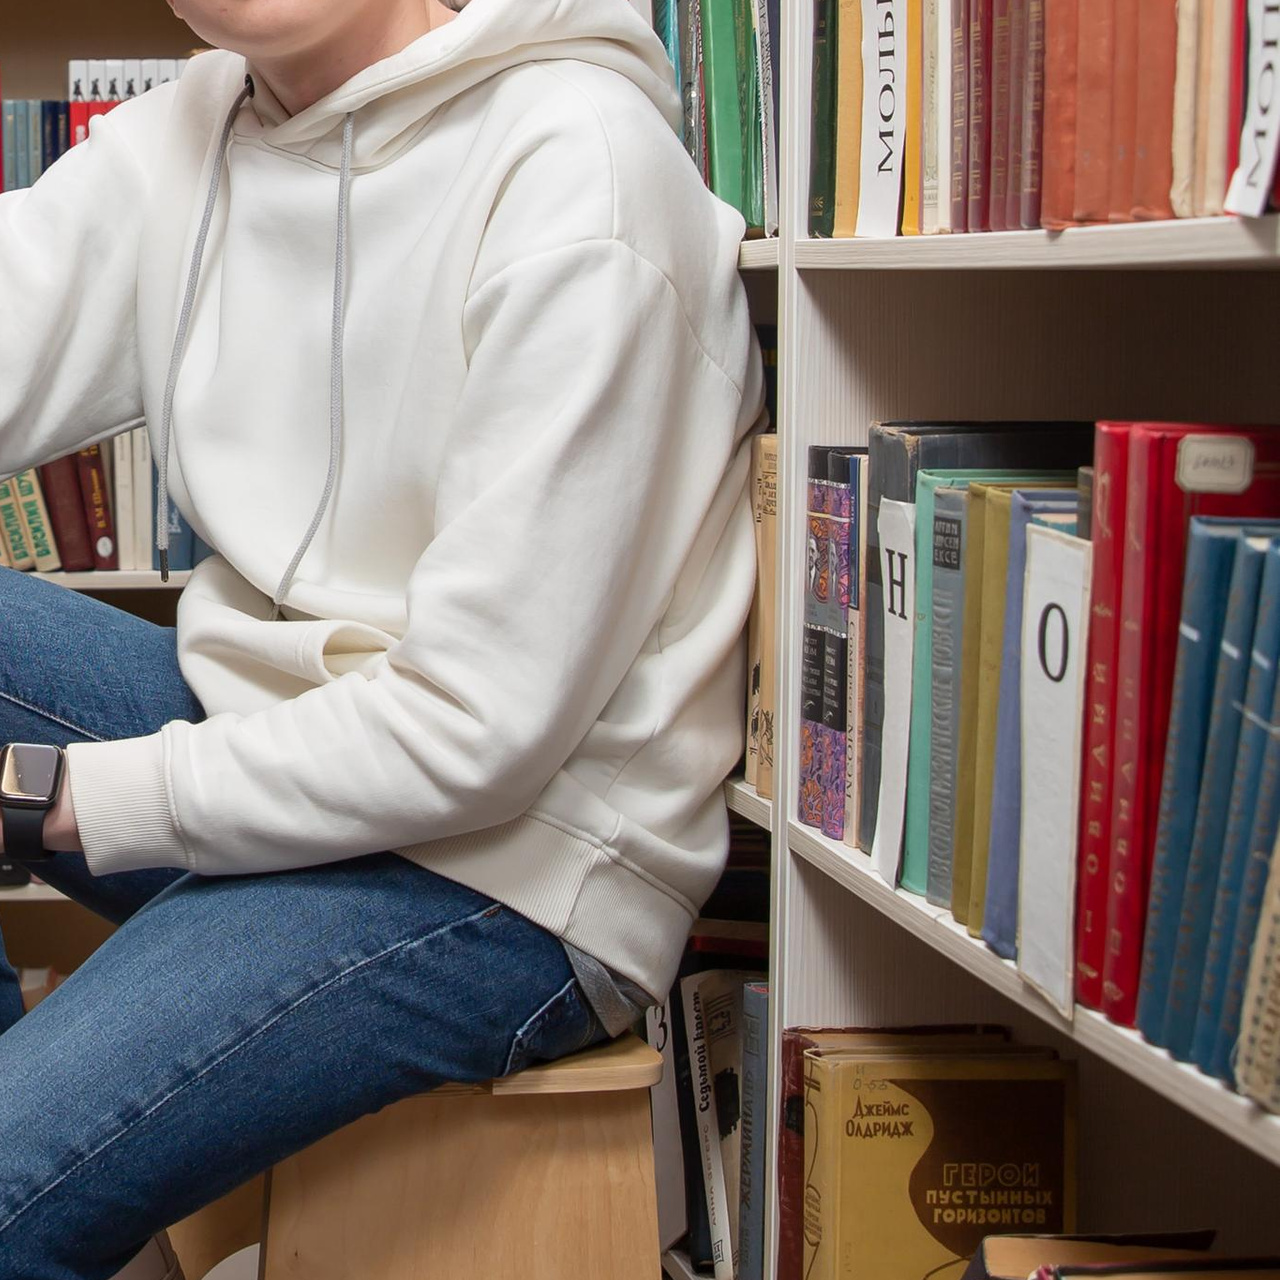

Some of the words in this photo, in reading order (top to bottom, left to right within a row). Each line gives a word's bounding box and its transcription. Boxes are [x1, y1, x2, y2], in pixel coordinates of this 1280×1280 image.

[886, 548, 908, 619] Н
[1037, 601, 1070, 683] О
[693, 1043, 712, 1113] Седьмой
[925, 1187, 1053, 1207] ПУСТЫННЫХ
[942, 1162, 1040, 1189] ГЕРОИ
[932, 1207, 1046, 1225] ГОРИЗОНТОВ
